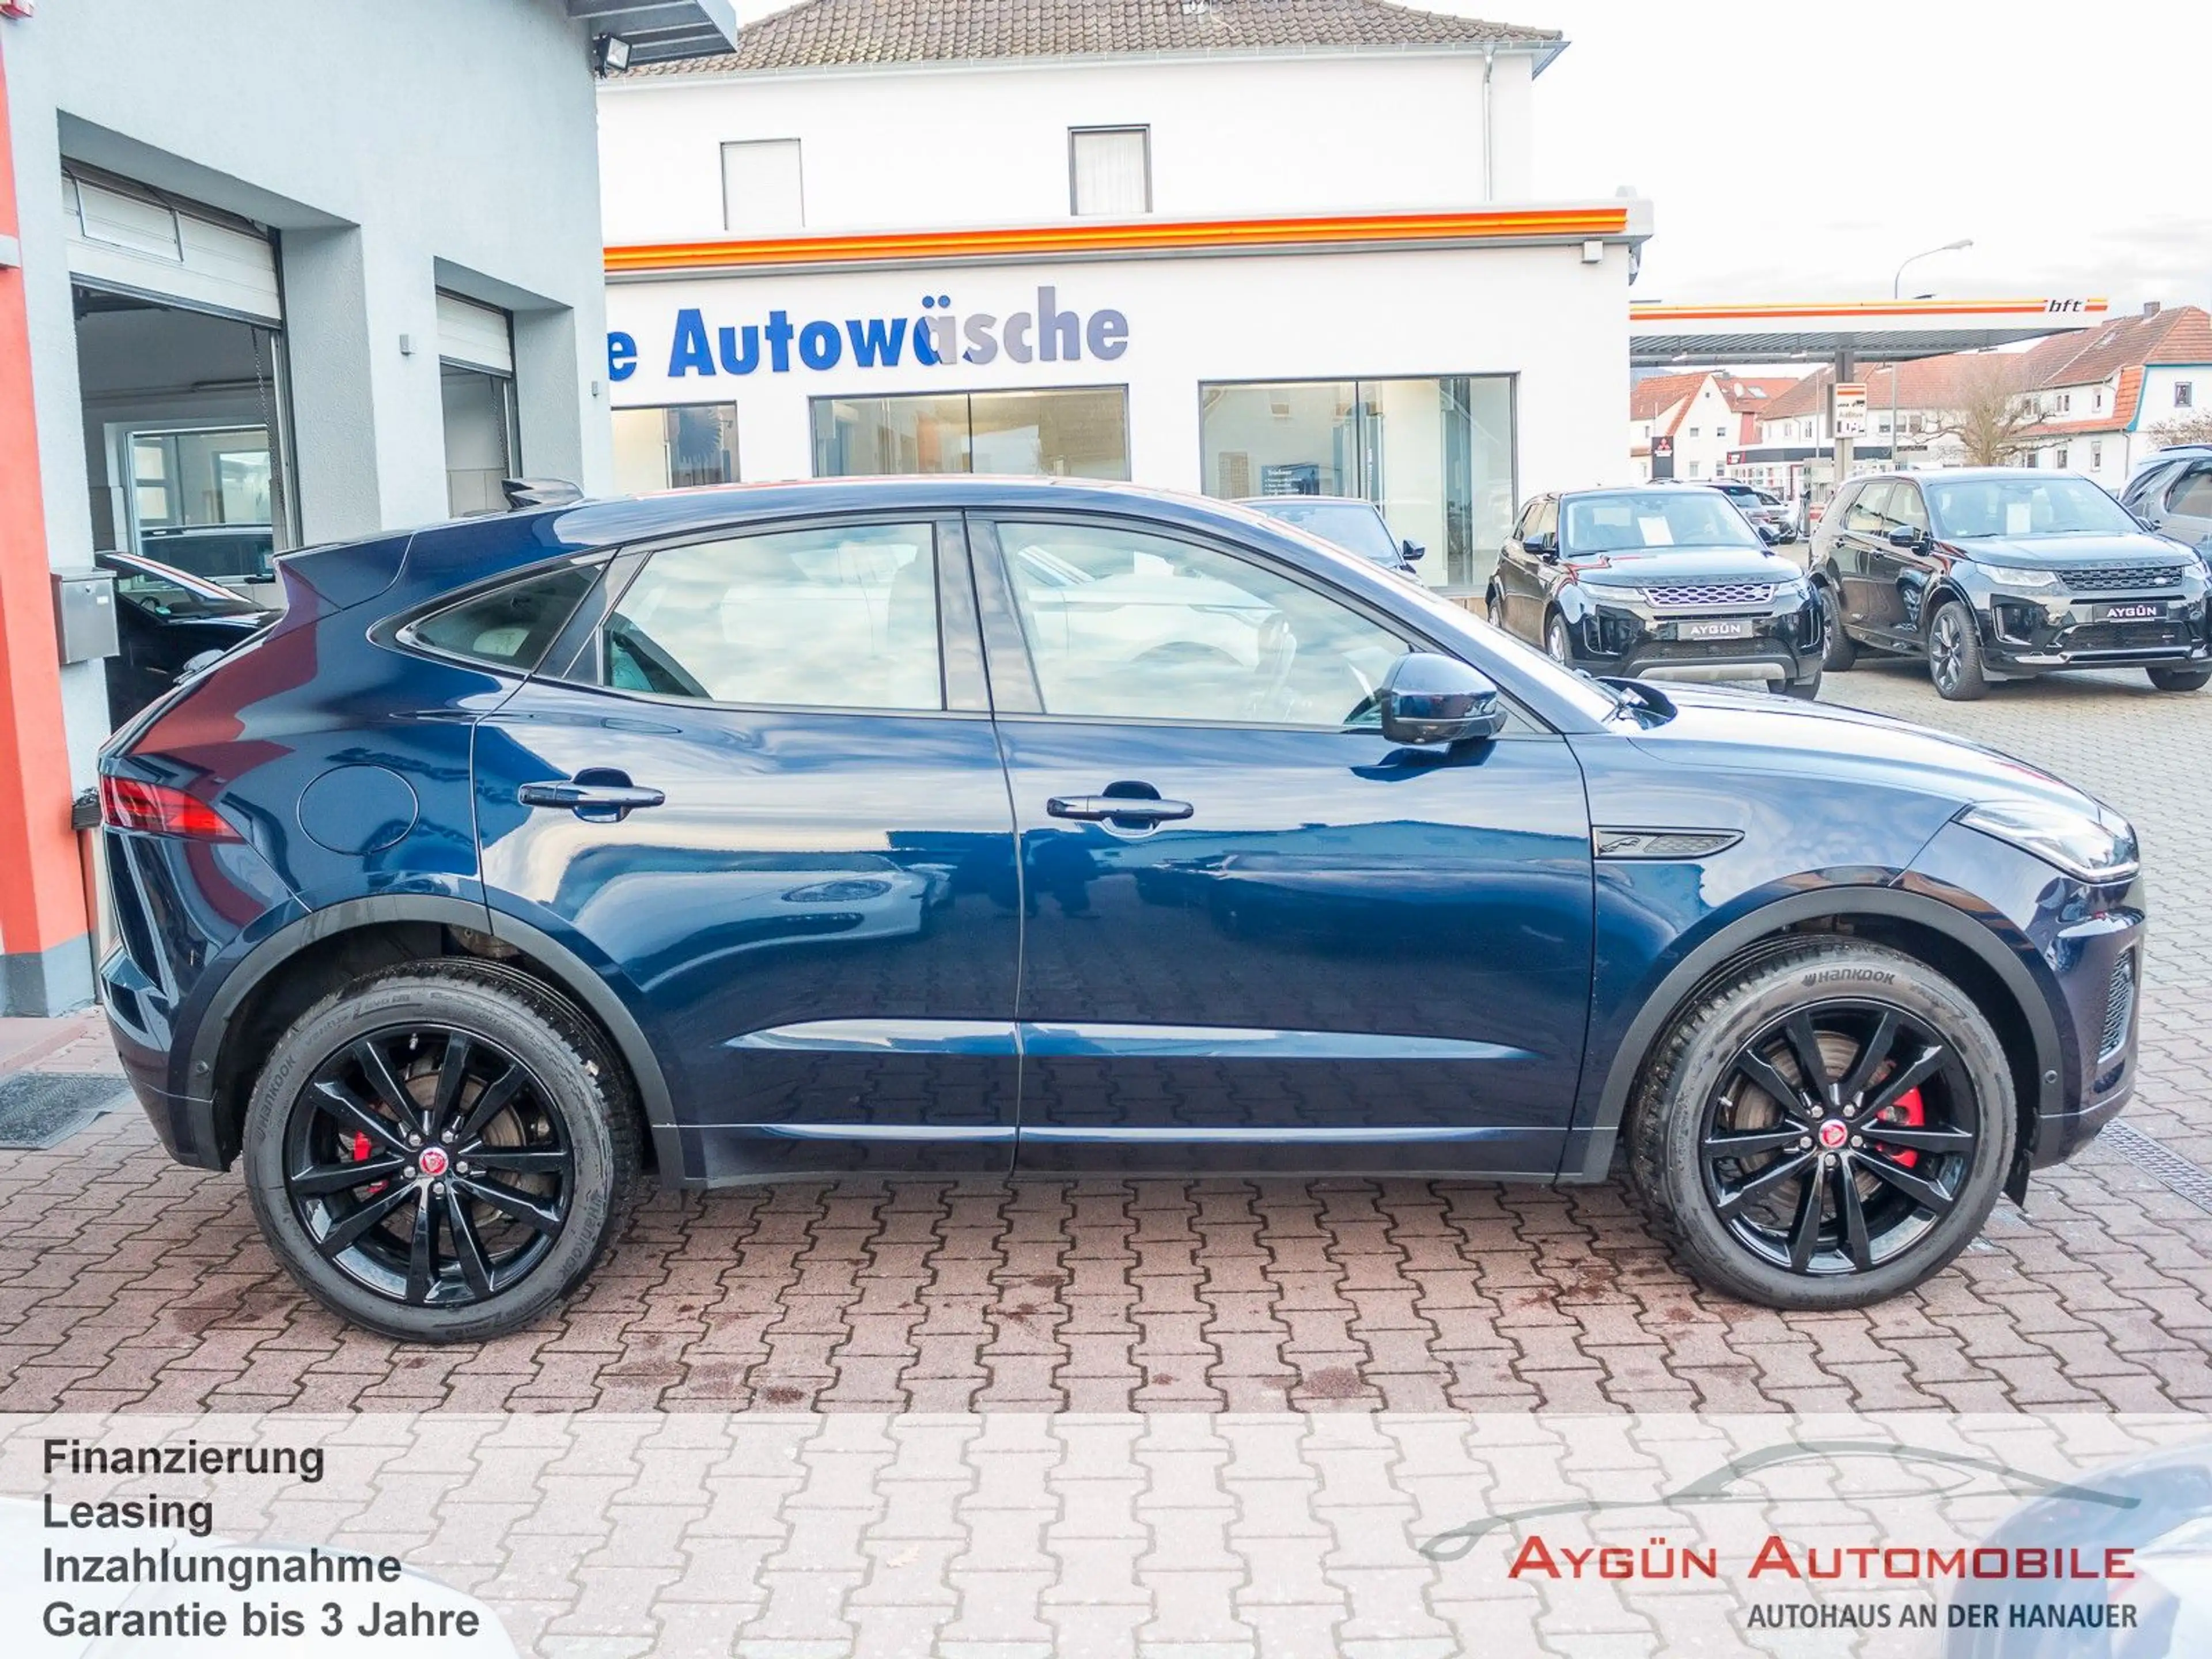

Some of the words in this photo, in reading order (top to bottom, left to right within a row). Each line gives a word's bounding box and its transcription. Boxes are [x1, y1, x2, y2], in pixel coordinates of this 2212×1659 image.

[2048, 298, 2083, 312] bft
[668, 286, 1128, 377] Autowäsche
[2107, 604, 2158, 619] AYGÜN
[1690, 622, 1742, 635] AYGÜN
